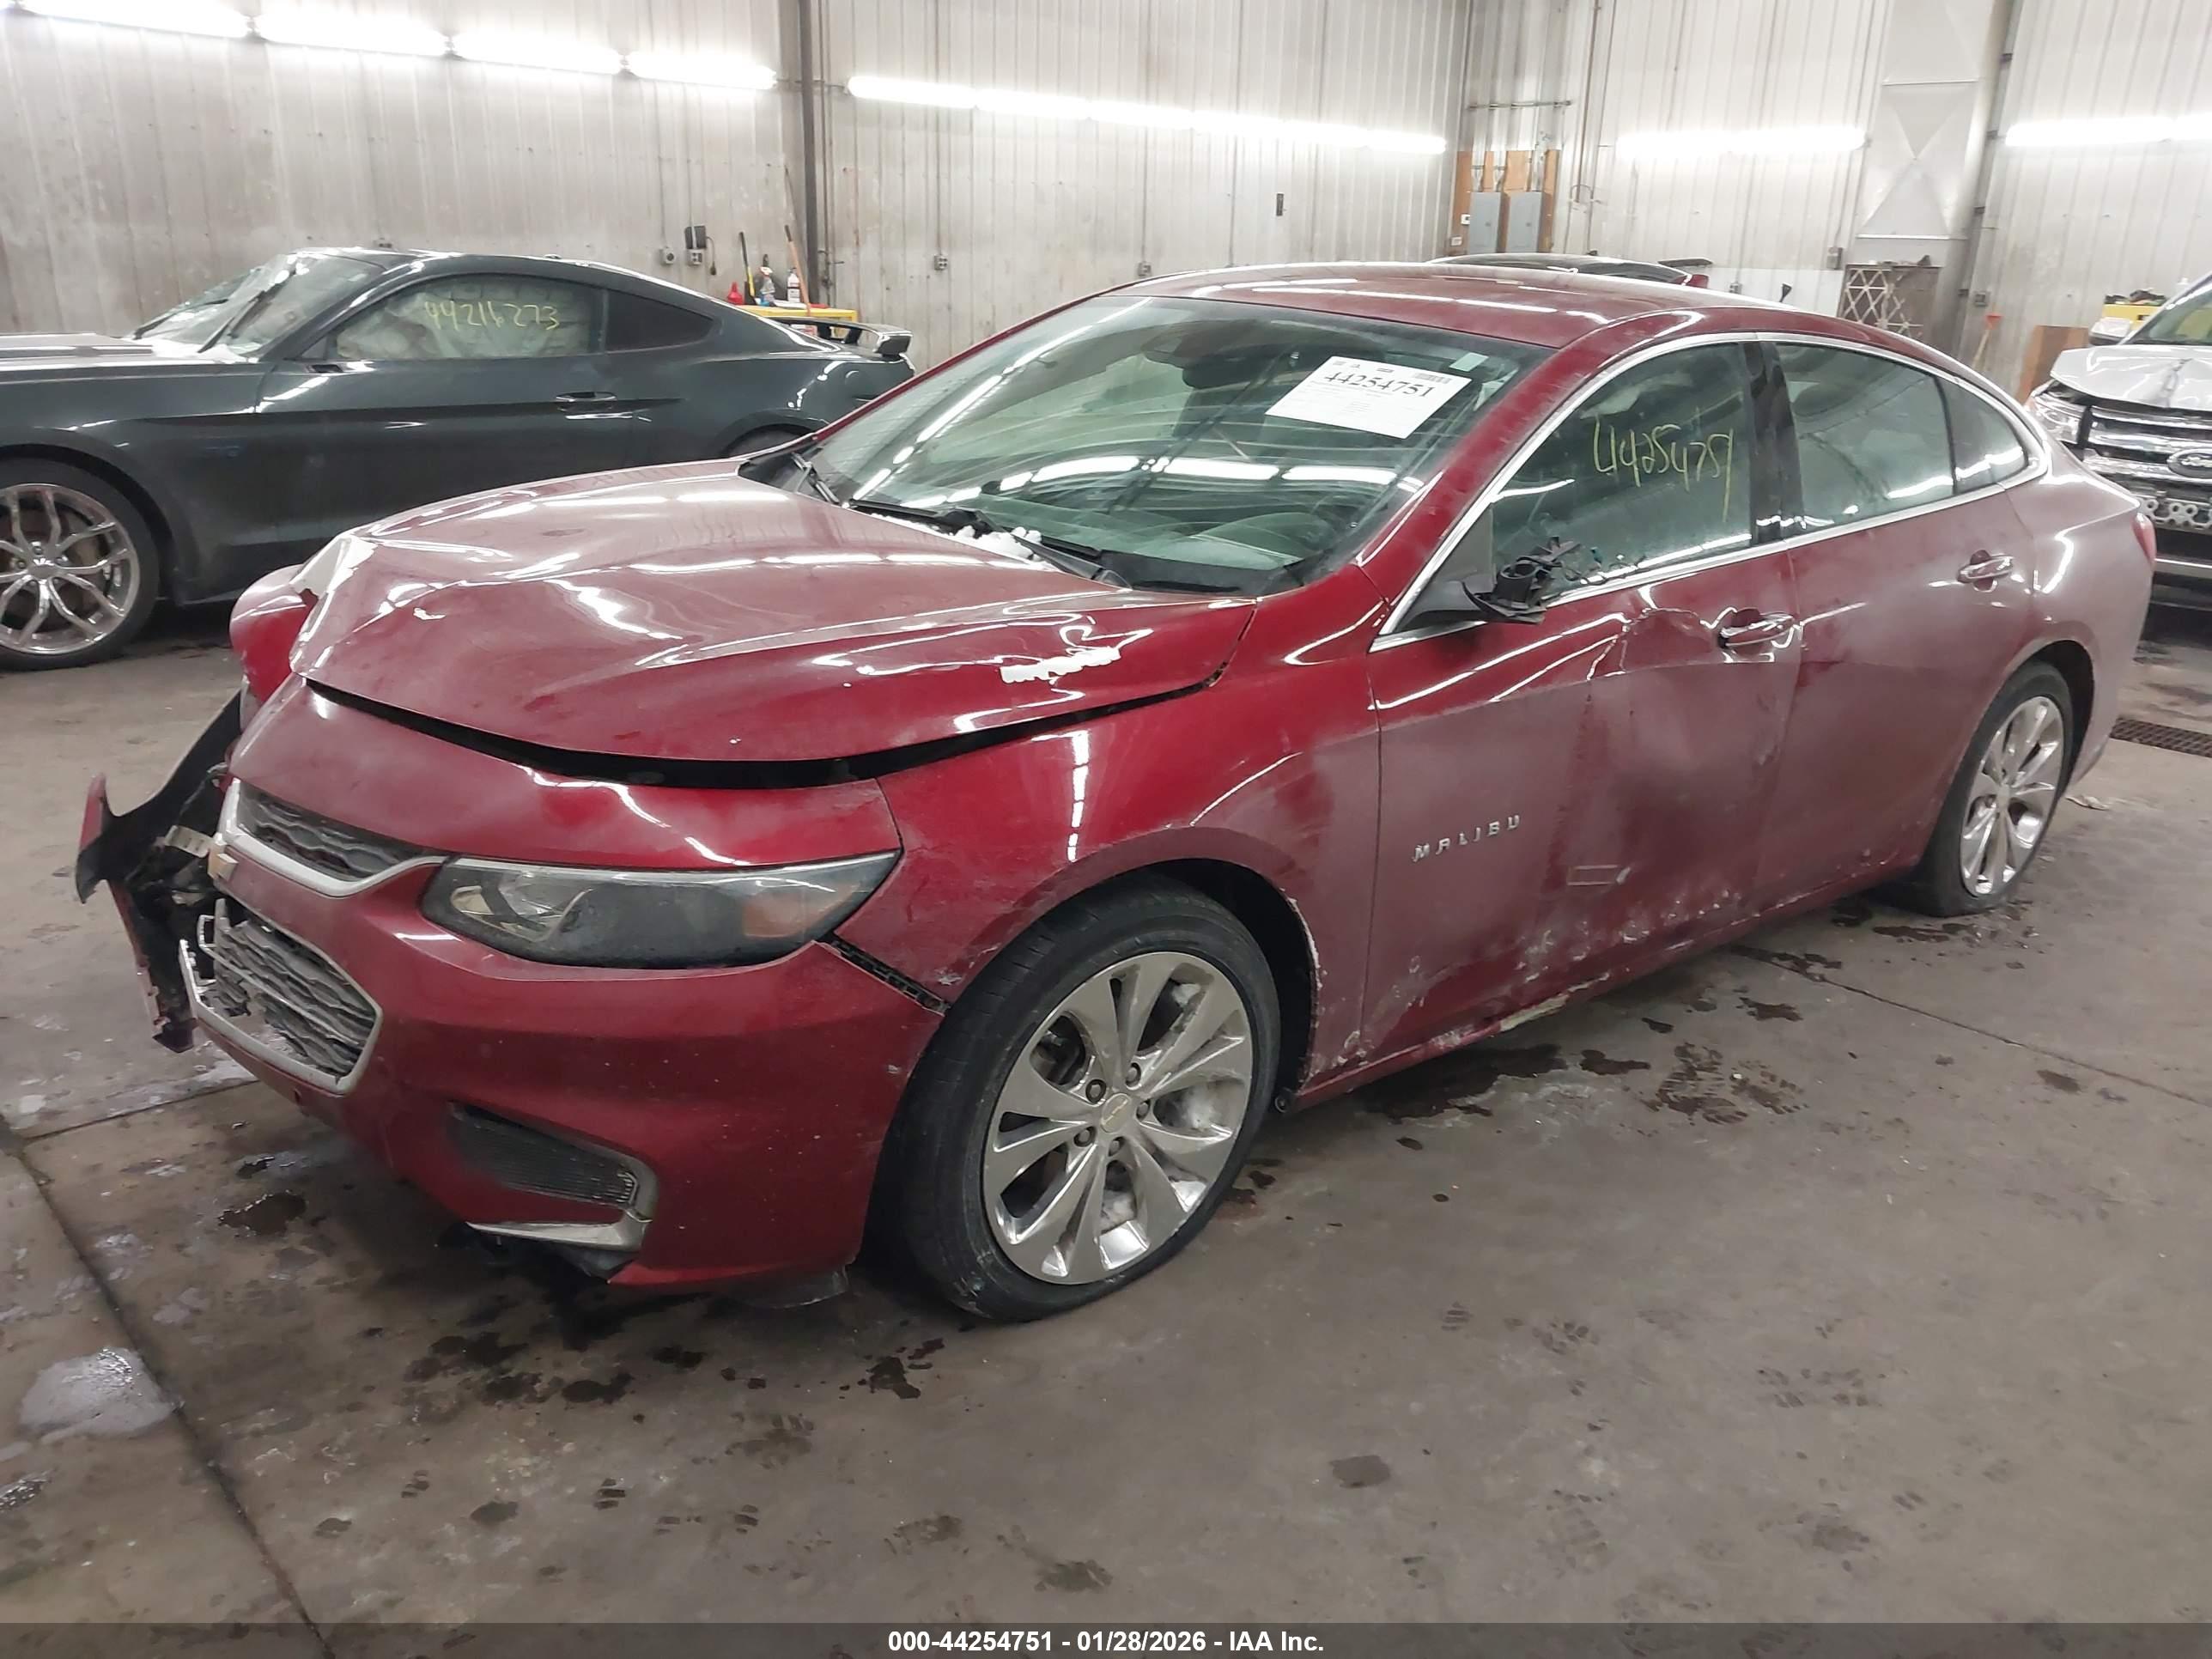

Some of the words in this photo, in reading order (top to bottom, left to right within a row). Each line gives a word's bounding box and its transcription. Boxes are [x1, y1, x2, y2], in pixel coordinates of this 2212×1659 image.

[424, 301, 560, 331] 44216273
[1324, 371, 1436, 398] 44254751
[1592, 415, 1735, 523] 44254751
[1413, 815, 1521, 862] MALIBU
